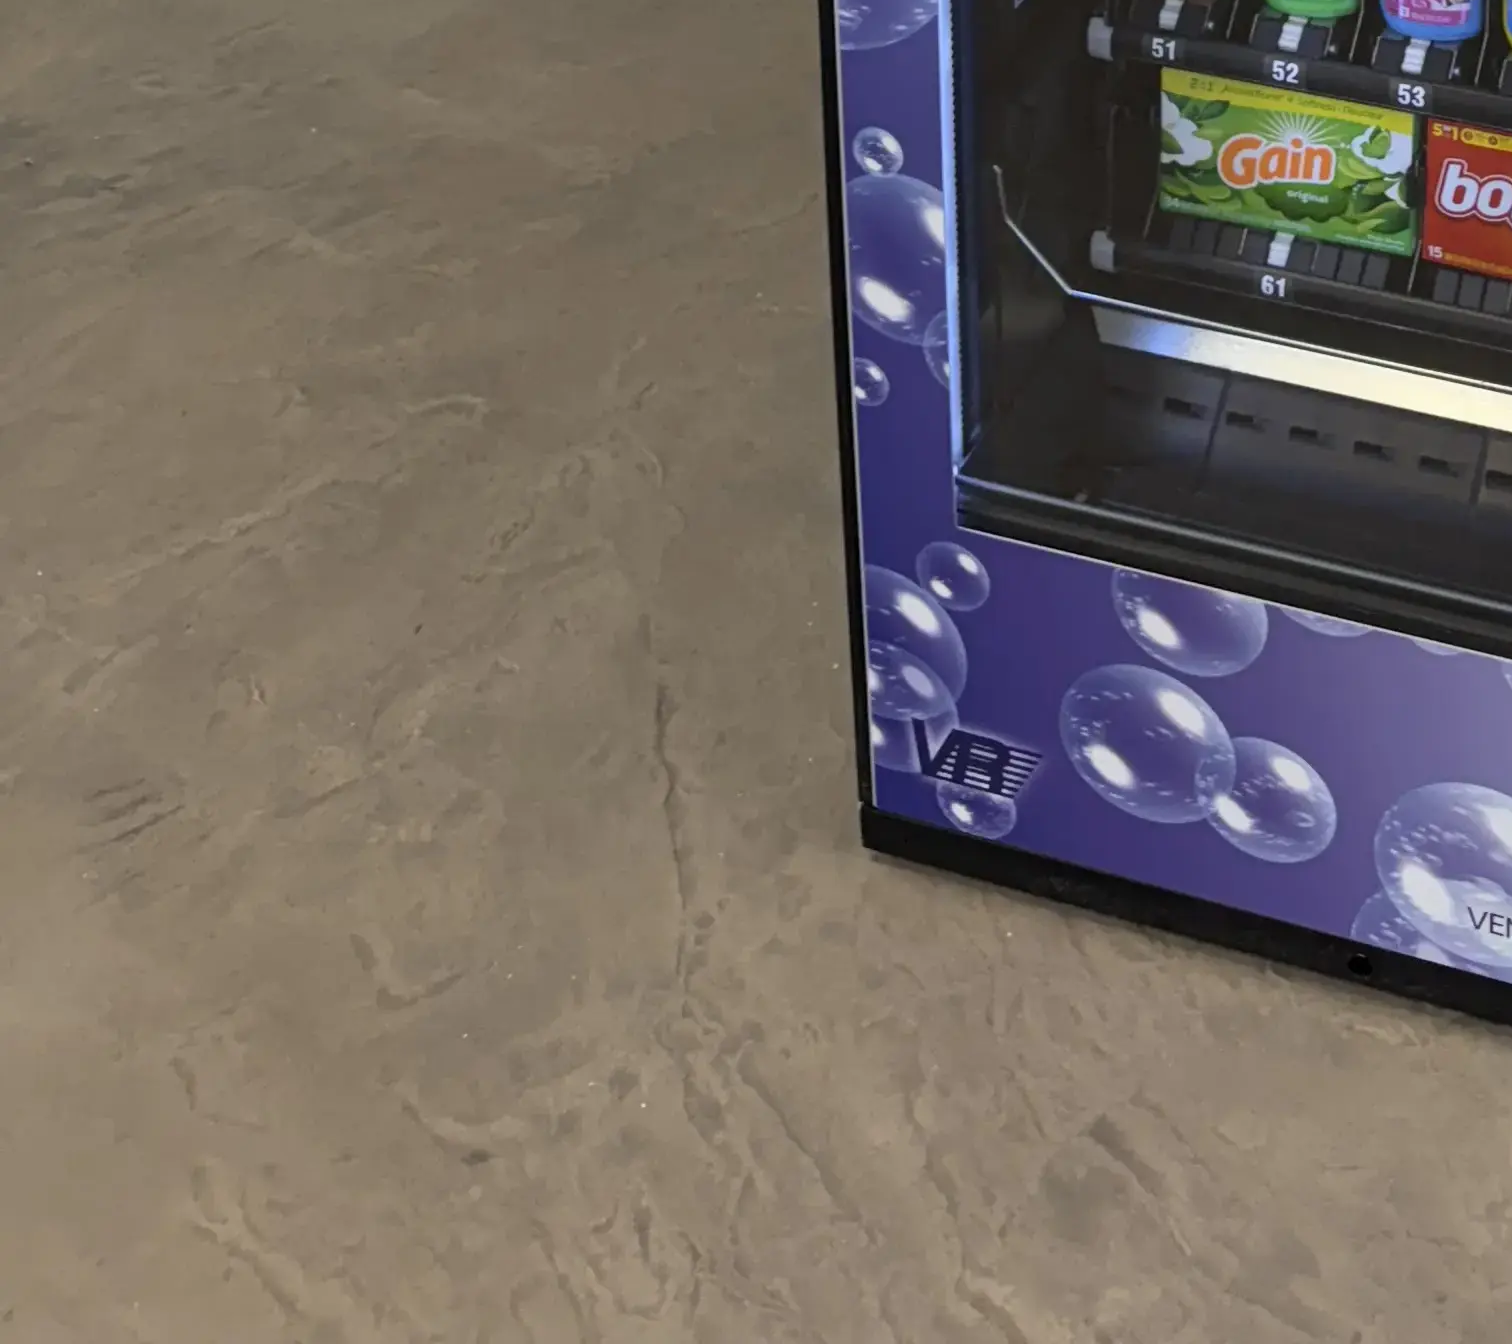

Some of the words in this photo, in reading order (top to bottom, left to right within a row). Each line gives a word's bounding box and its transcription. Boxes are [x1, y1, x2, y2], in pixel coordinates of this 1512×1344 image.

[1152, 39, 1177, 60] 51
[1272, 61, 1299, 83] 52
[1398, 84, 1426, 107] 53
[1220, 136, 1333, 187] Gain
[1287, 190, 1329, 203] original
[1428, 245, 1443, 259] 15
[1261, 275, 1286, 297] 61
